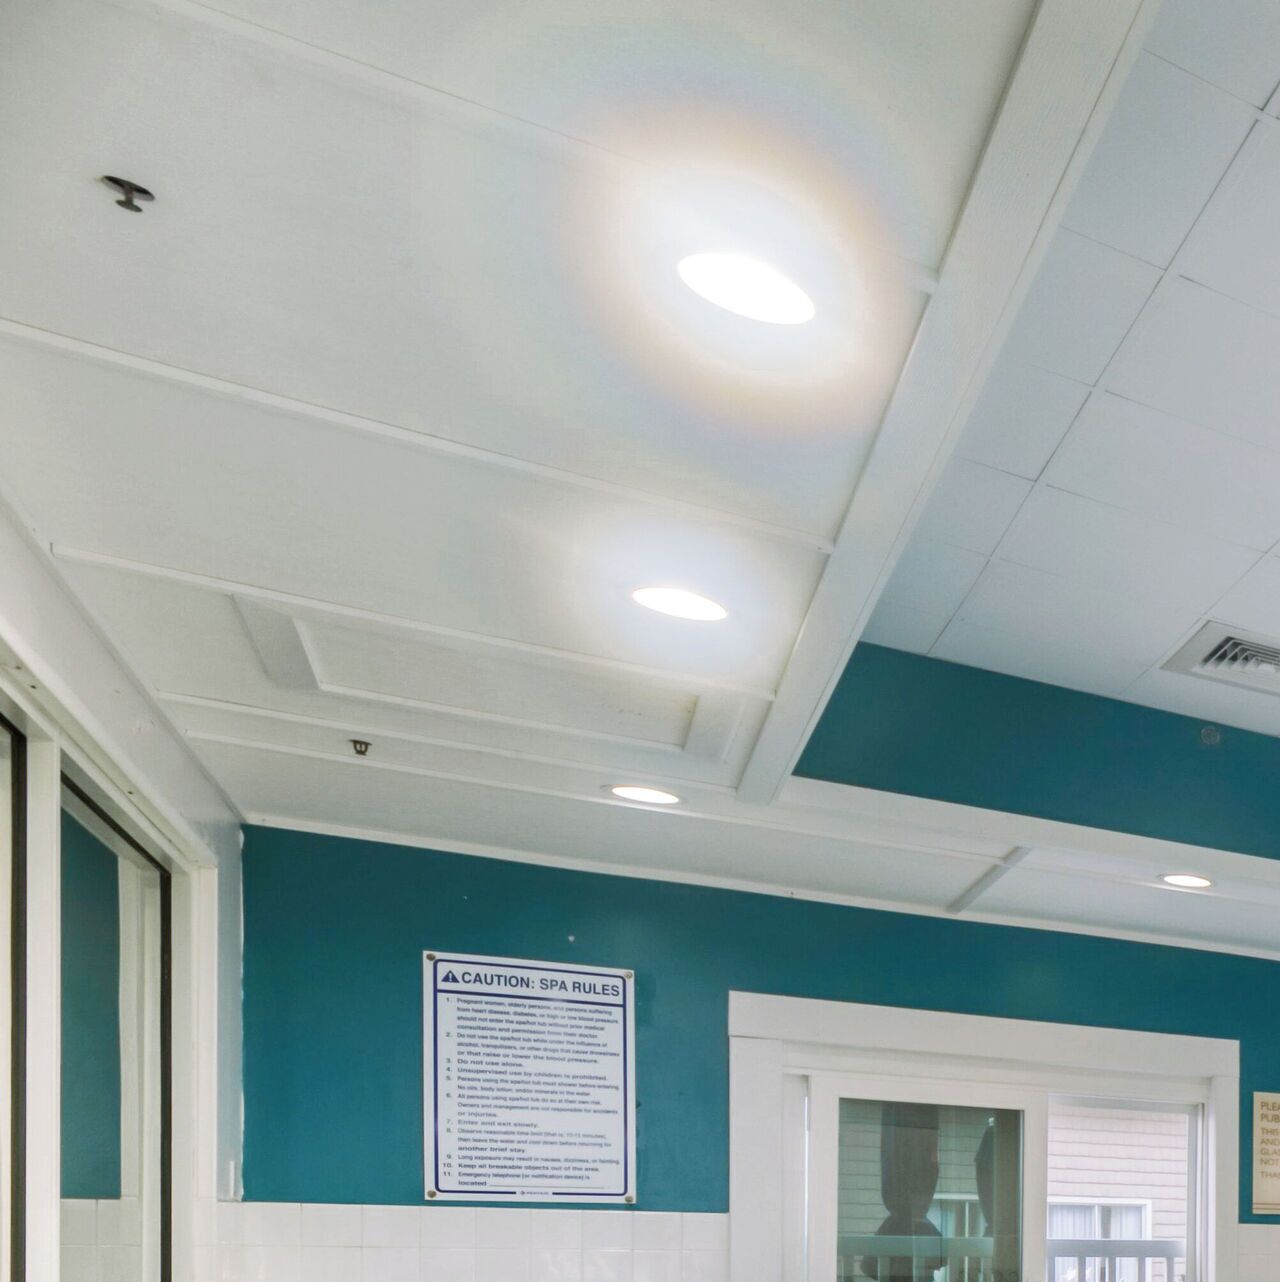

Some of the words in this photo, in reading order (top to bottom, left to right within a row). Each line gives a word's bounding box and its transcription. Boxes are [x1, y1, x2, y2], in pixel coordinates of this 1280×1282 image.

[462, 971, 535, 989] CAUTION:
[540, 978, 568, 992] SPA
[572, 981, 620, 997] RULES
[1261, 1128, 1279, 1136] THIS
[1260, 1138, 1280, 1146] AND
